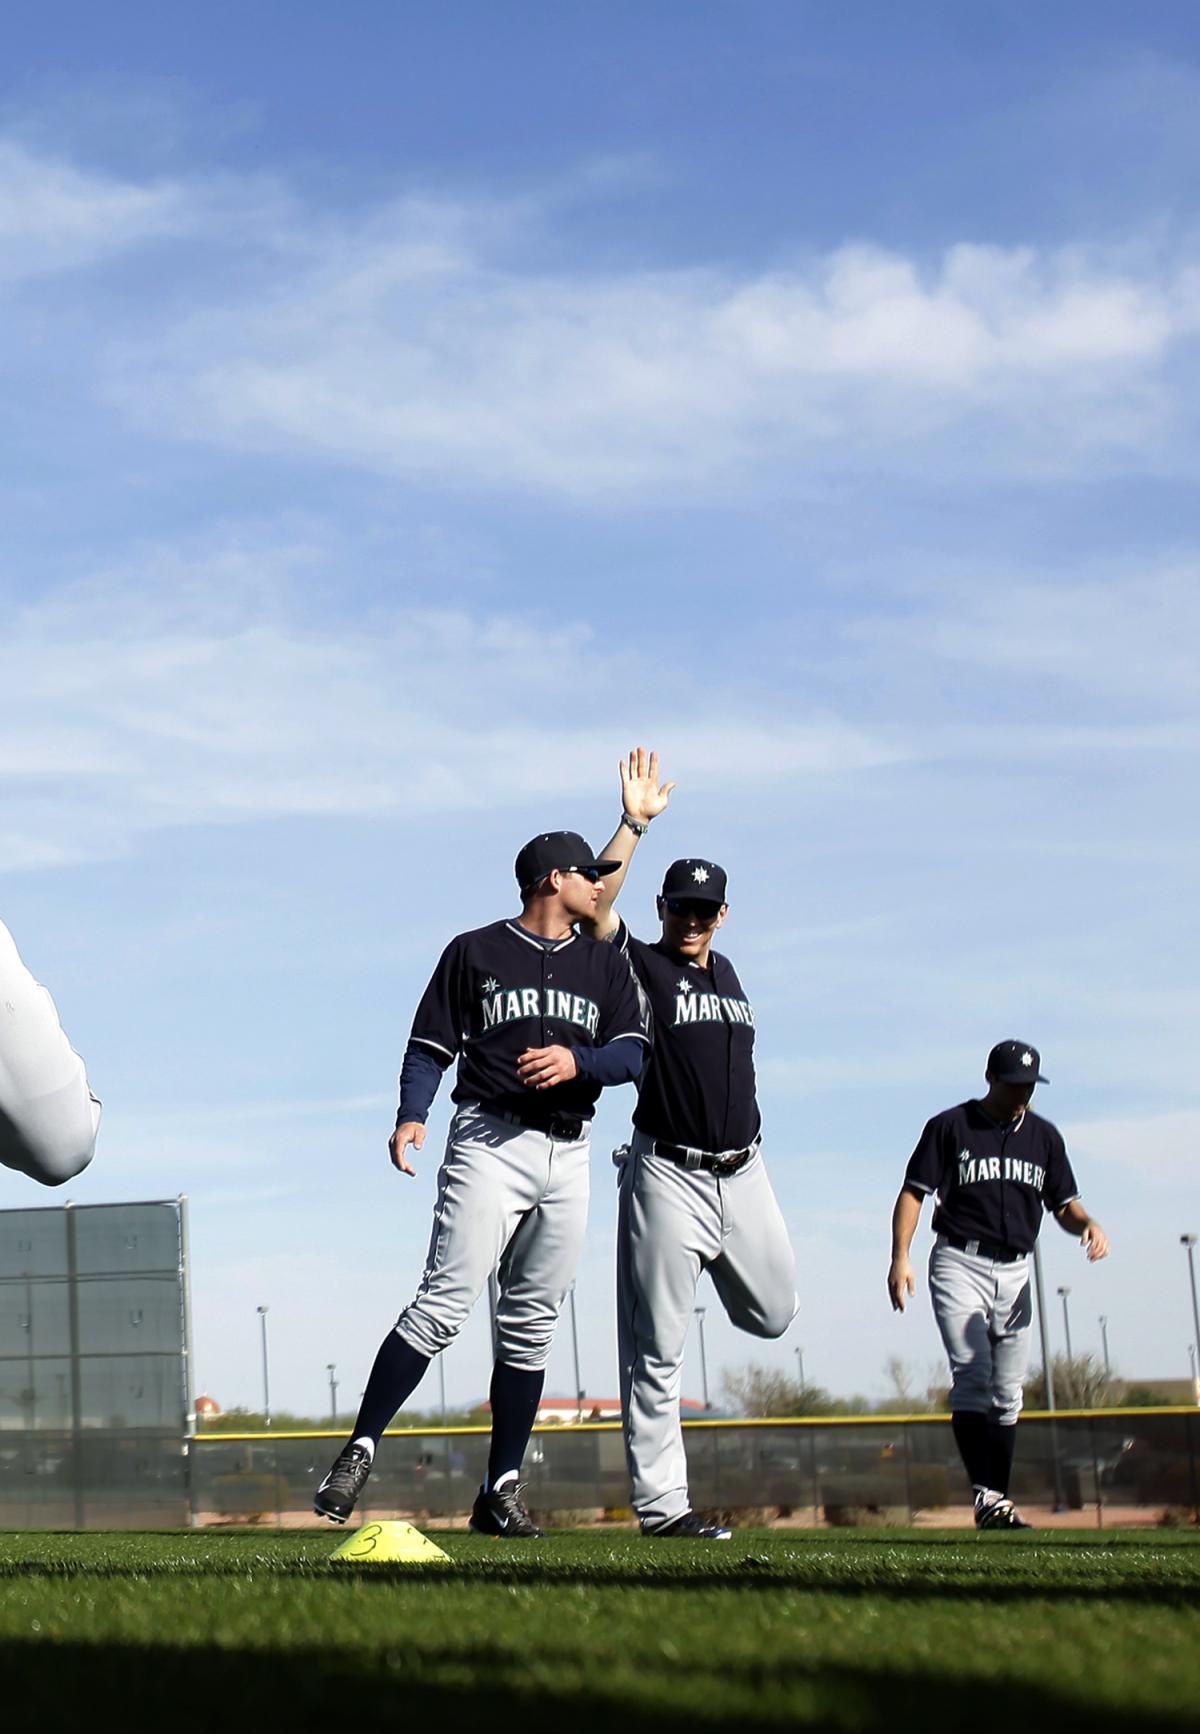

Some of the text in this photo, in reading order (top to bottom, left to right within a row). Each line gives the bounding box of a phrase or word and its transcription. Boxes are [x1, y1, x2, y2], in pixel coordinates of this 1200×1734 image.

[481, 987, 601, 1040] MARINER
[958, 1156, 1046, 1192] MARINER
[349, 1524, 383, 1557] 3
